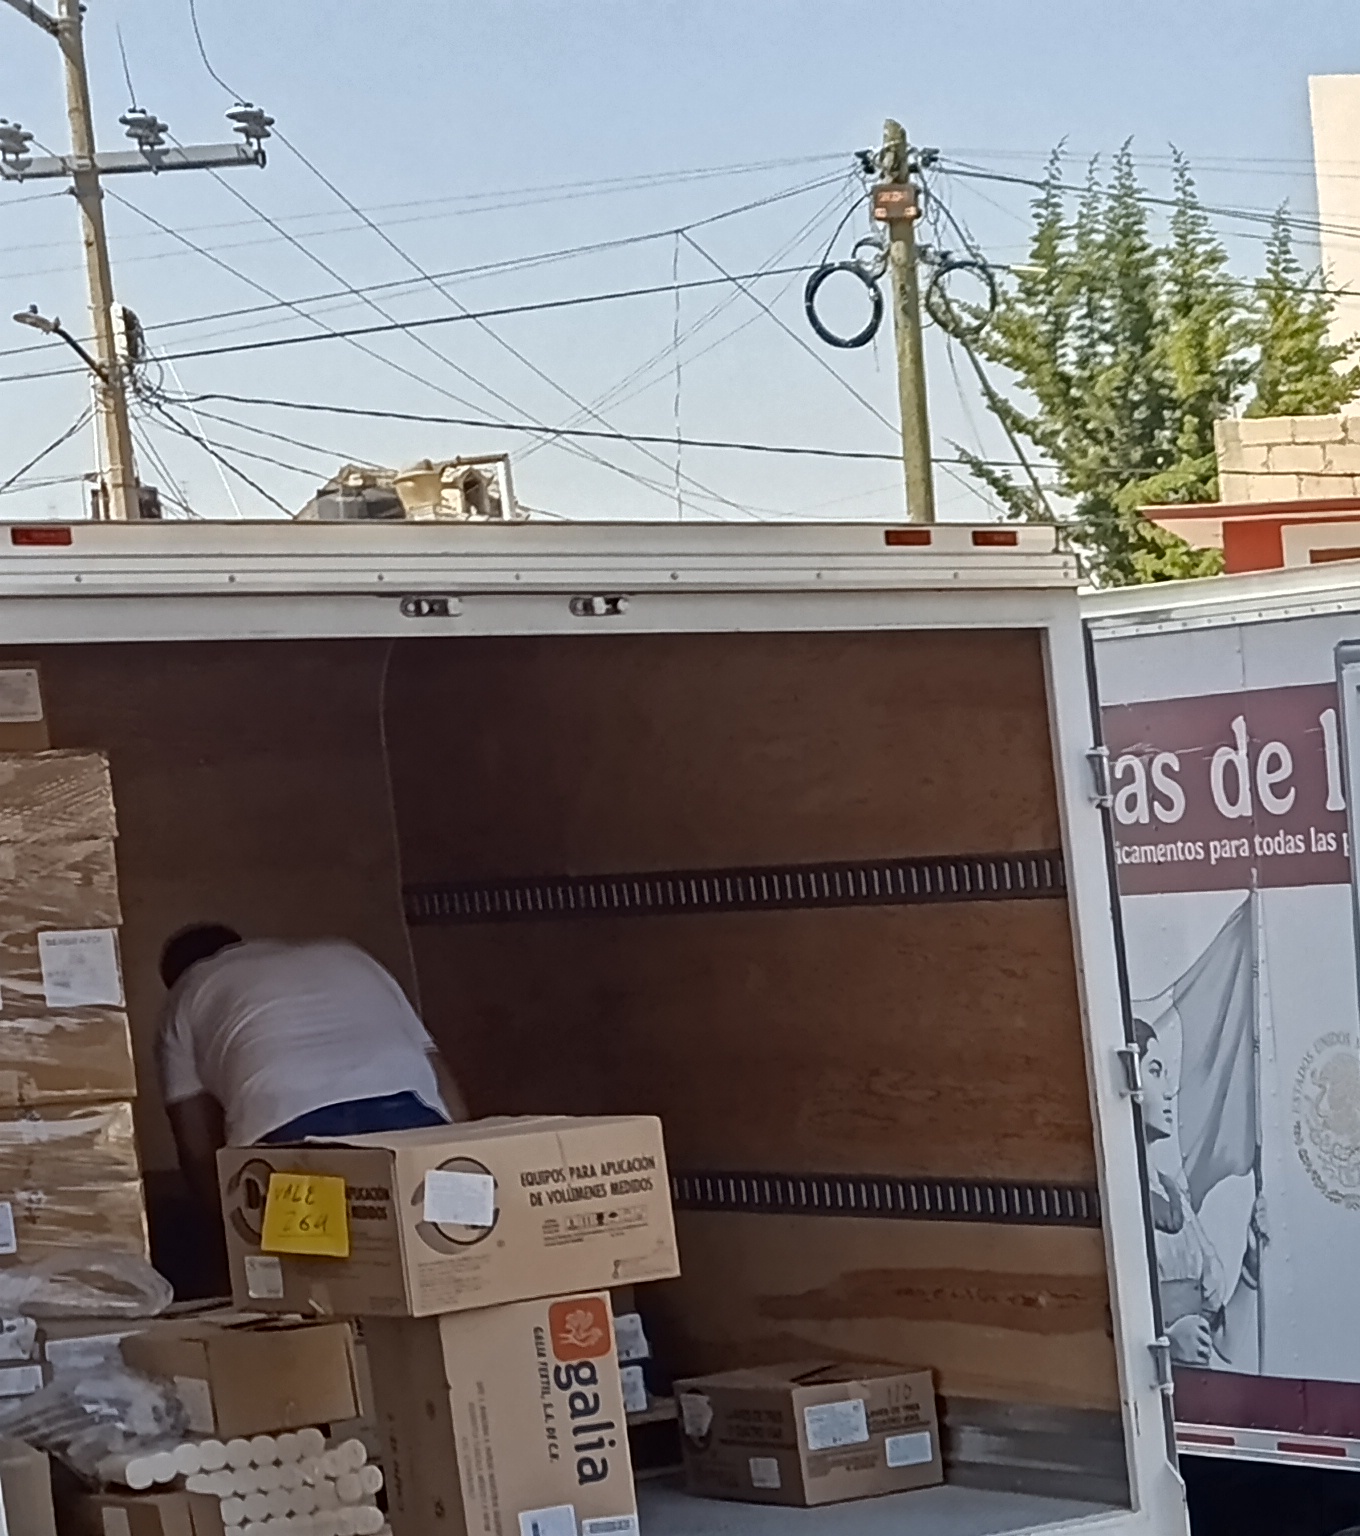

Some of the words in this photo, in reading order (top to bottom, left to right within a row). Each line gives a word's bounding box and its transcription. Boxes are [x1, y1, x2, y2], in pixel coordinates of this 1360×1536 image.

[1114, 752, 1186, 825] as
[1210, 714, 1297, 819] de
[1210, 836, 1250, 866] para
[1254, 829, 1306, 857] todas
[1310, 826, 1337, 854] las
[520, 1168, 566, 1188] EQUIPOS
[568, 1163, 599, 1182] PARA
[600, 1154, 657, 1176] APLICACIÓN
[529, 1192, 544, 1207] DE
[610, 1176, 655, 1196] MEDIDOS
[554, 1361, 617, 1487] galia
